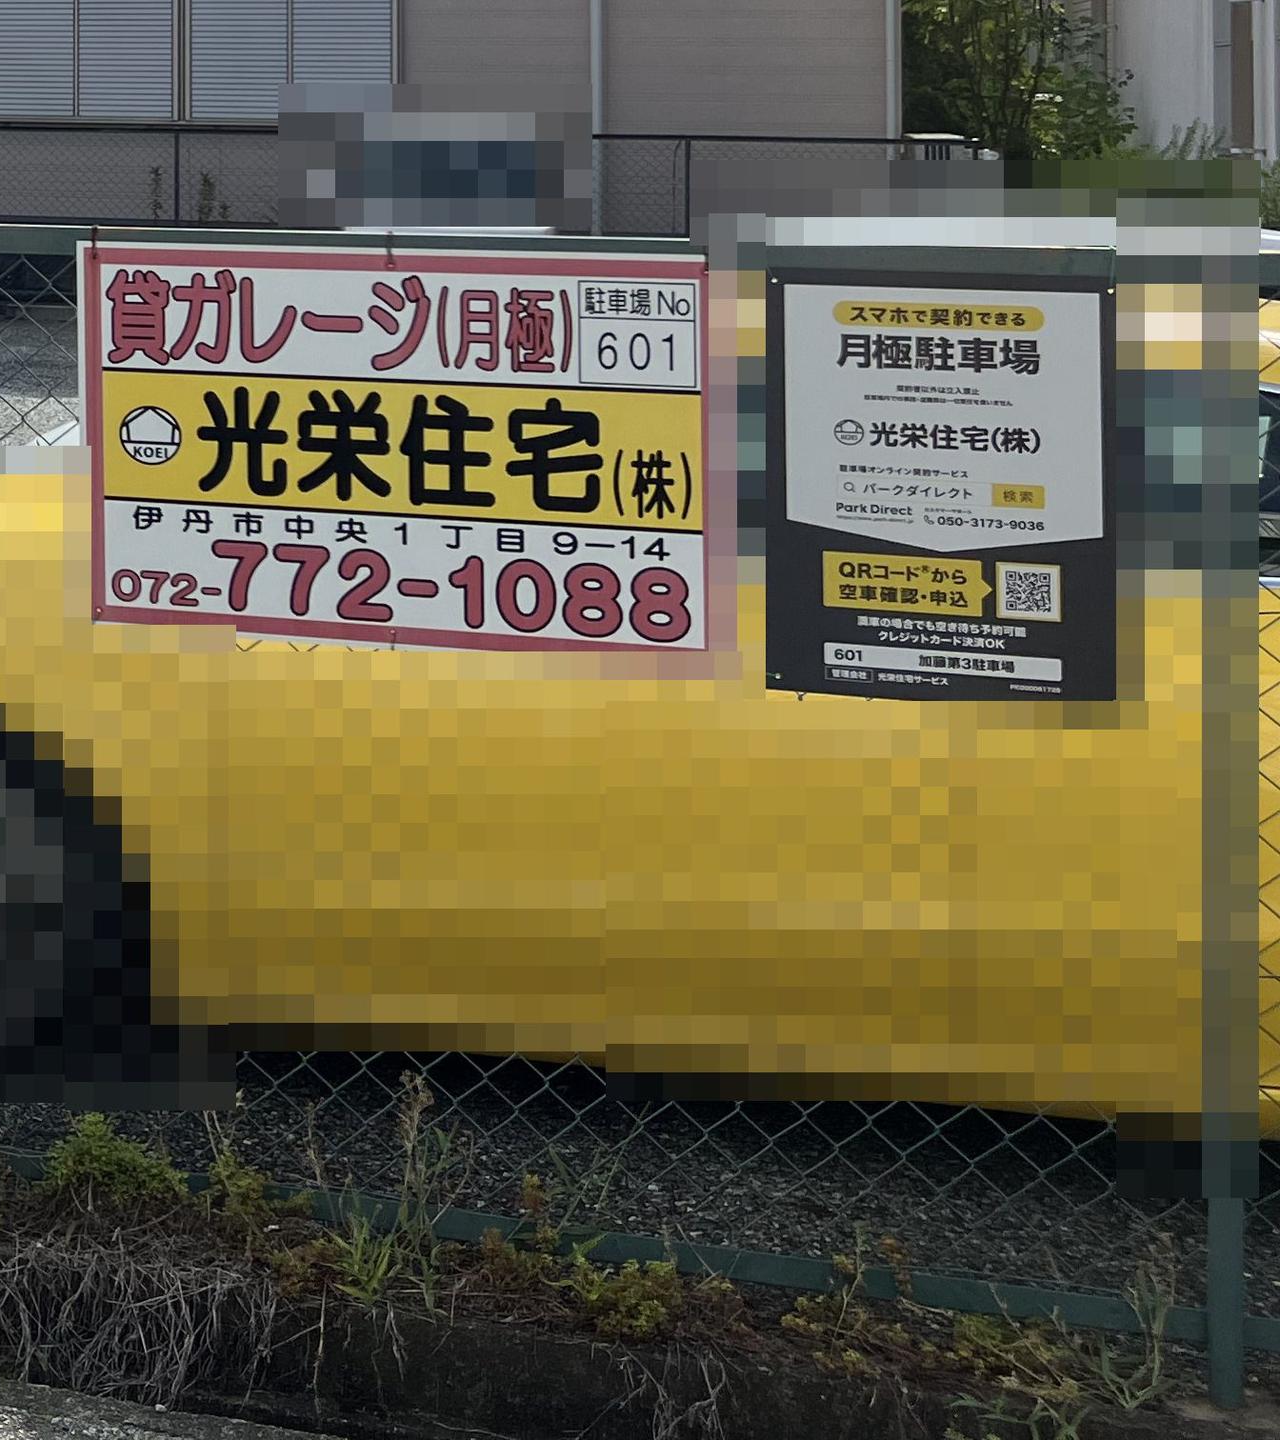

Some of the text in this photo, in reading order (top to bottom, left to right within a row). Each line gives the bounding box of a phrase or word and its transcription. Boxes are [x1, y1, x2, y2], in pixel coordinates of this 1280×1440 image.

[106, 268, 573, 374] 貸ガレージ(月極)
[849, 306, 1026, 327] スマホで契約できる
[598, 332, 674, 372] 601
[836, 333, 1040, 375] 月極駐車場
[869, 422, 1040, 454] 光栄住宅(株)
[133, 446, 168, 459] KOEI
[197, 386, 692, 520] 光栄住宅(株)
[836, 502, 867, 513] Park
[870, 504, 913, 516] Direct
[1003, 490, 1034, 503] 検索
[937, 516, 1045, 531] 050-3173-9036
[111, 539, 692, 643] 072-772-1088
[834, 649, 863, 661] 601
